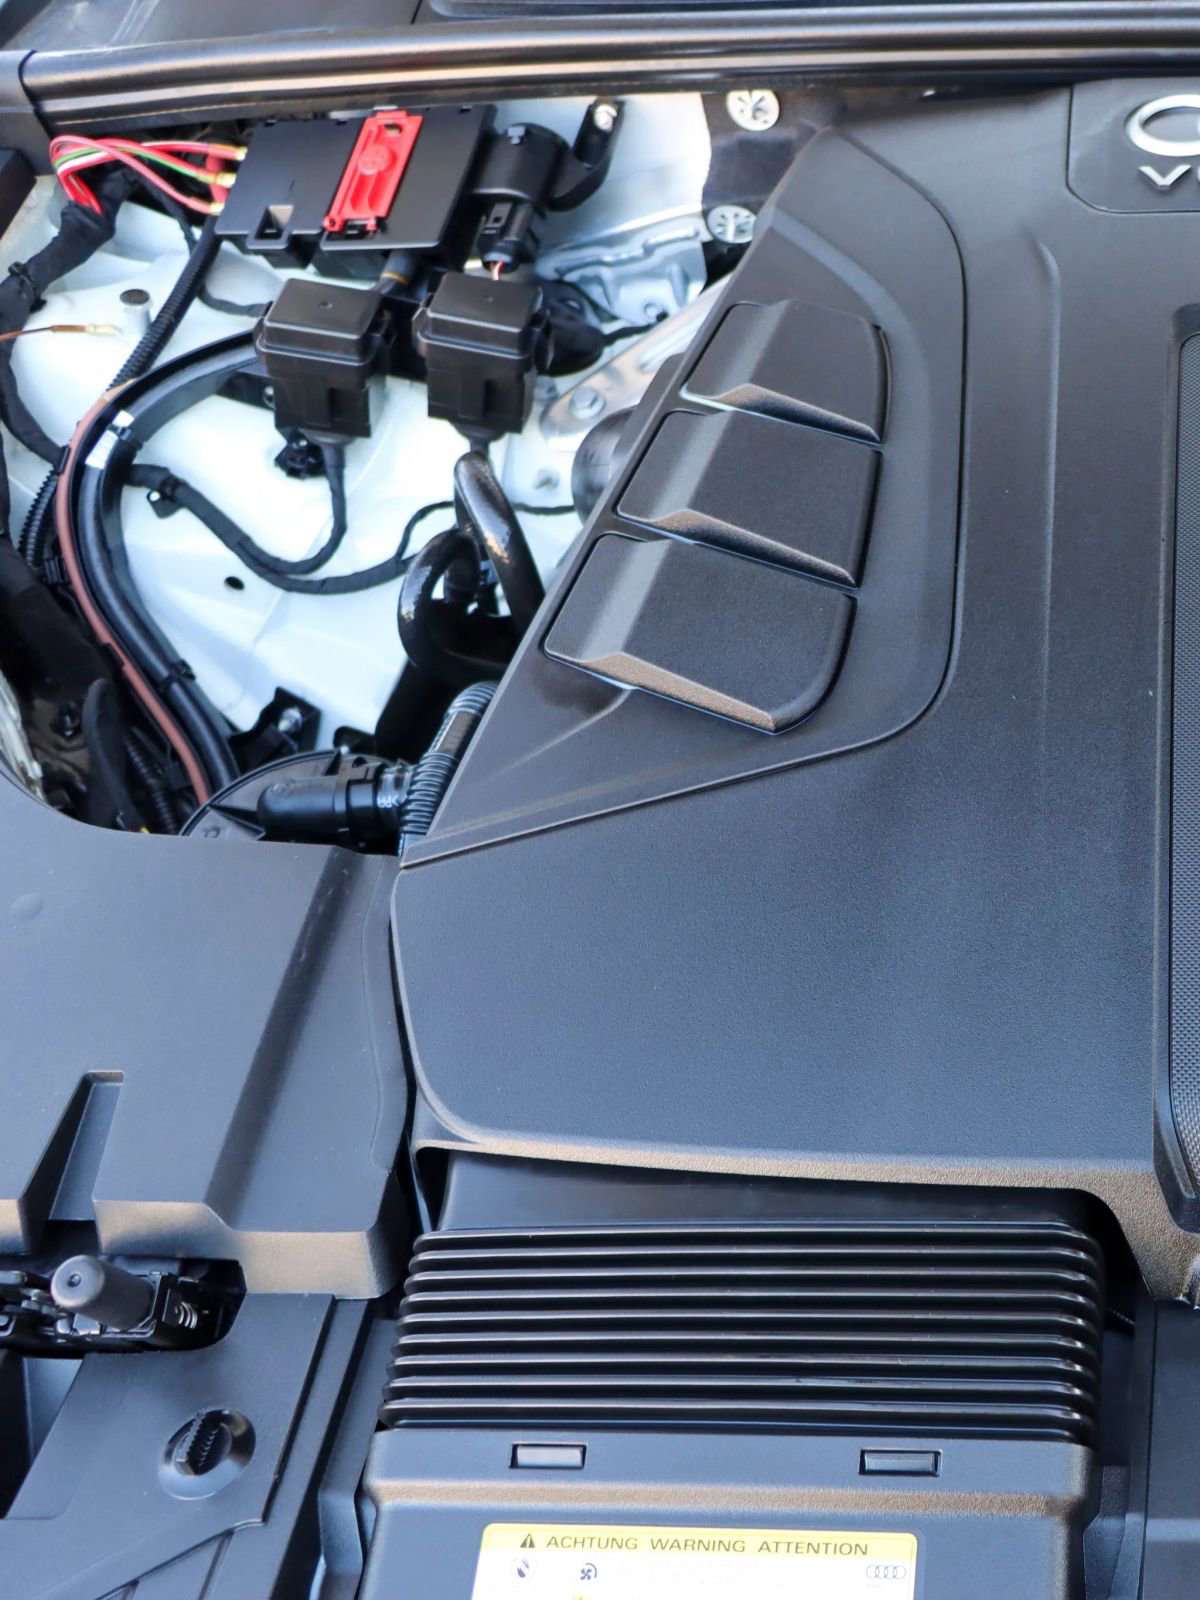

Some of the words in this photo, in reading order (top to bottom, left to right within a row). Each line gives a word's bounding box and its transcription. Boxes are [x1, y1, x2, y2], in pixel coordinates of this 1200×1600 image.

[546, 1535, 639, 1550] ACHTUNG
[650, 1537, 746, 1553] WARNING
[757, 1540, 868, 1556] ATTENTION
